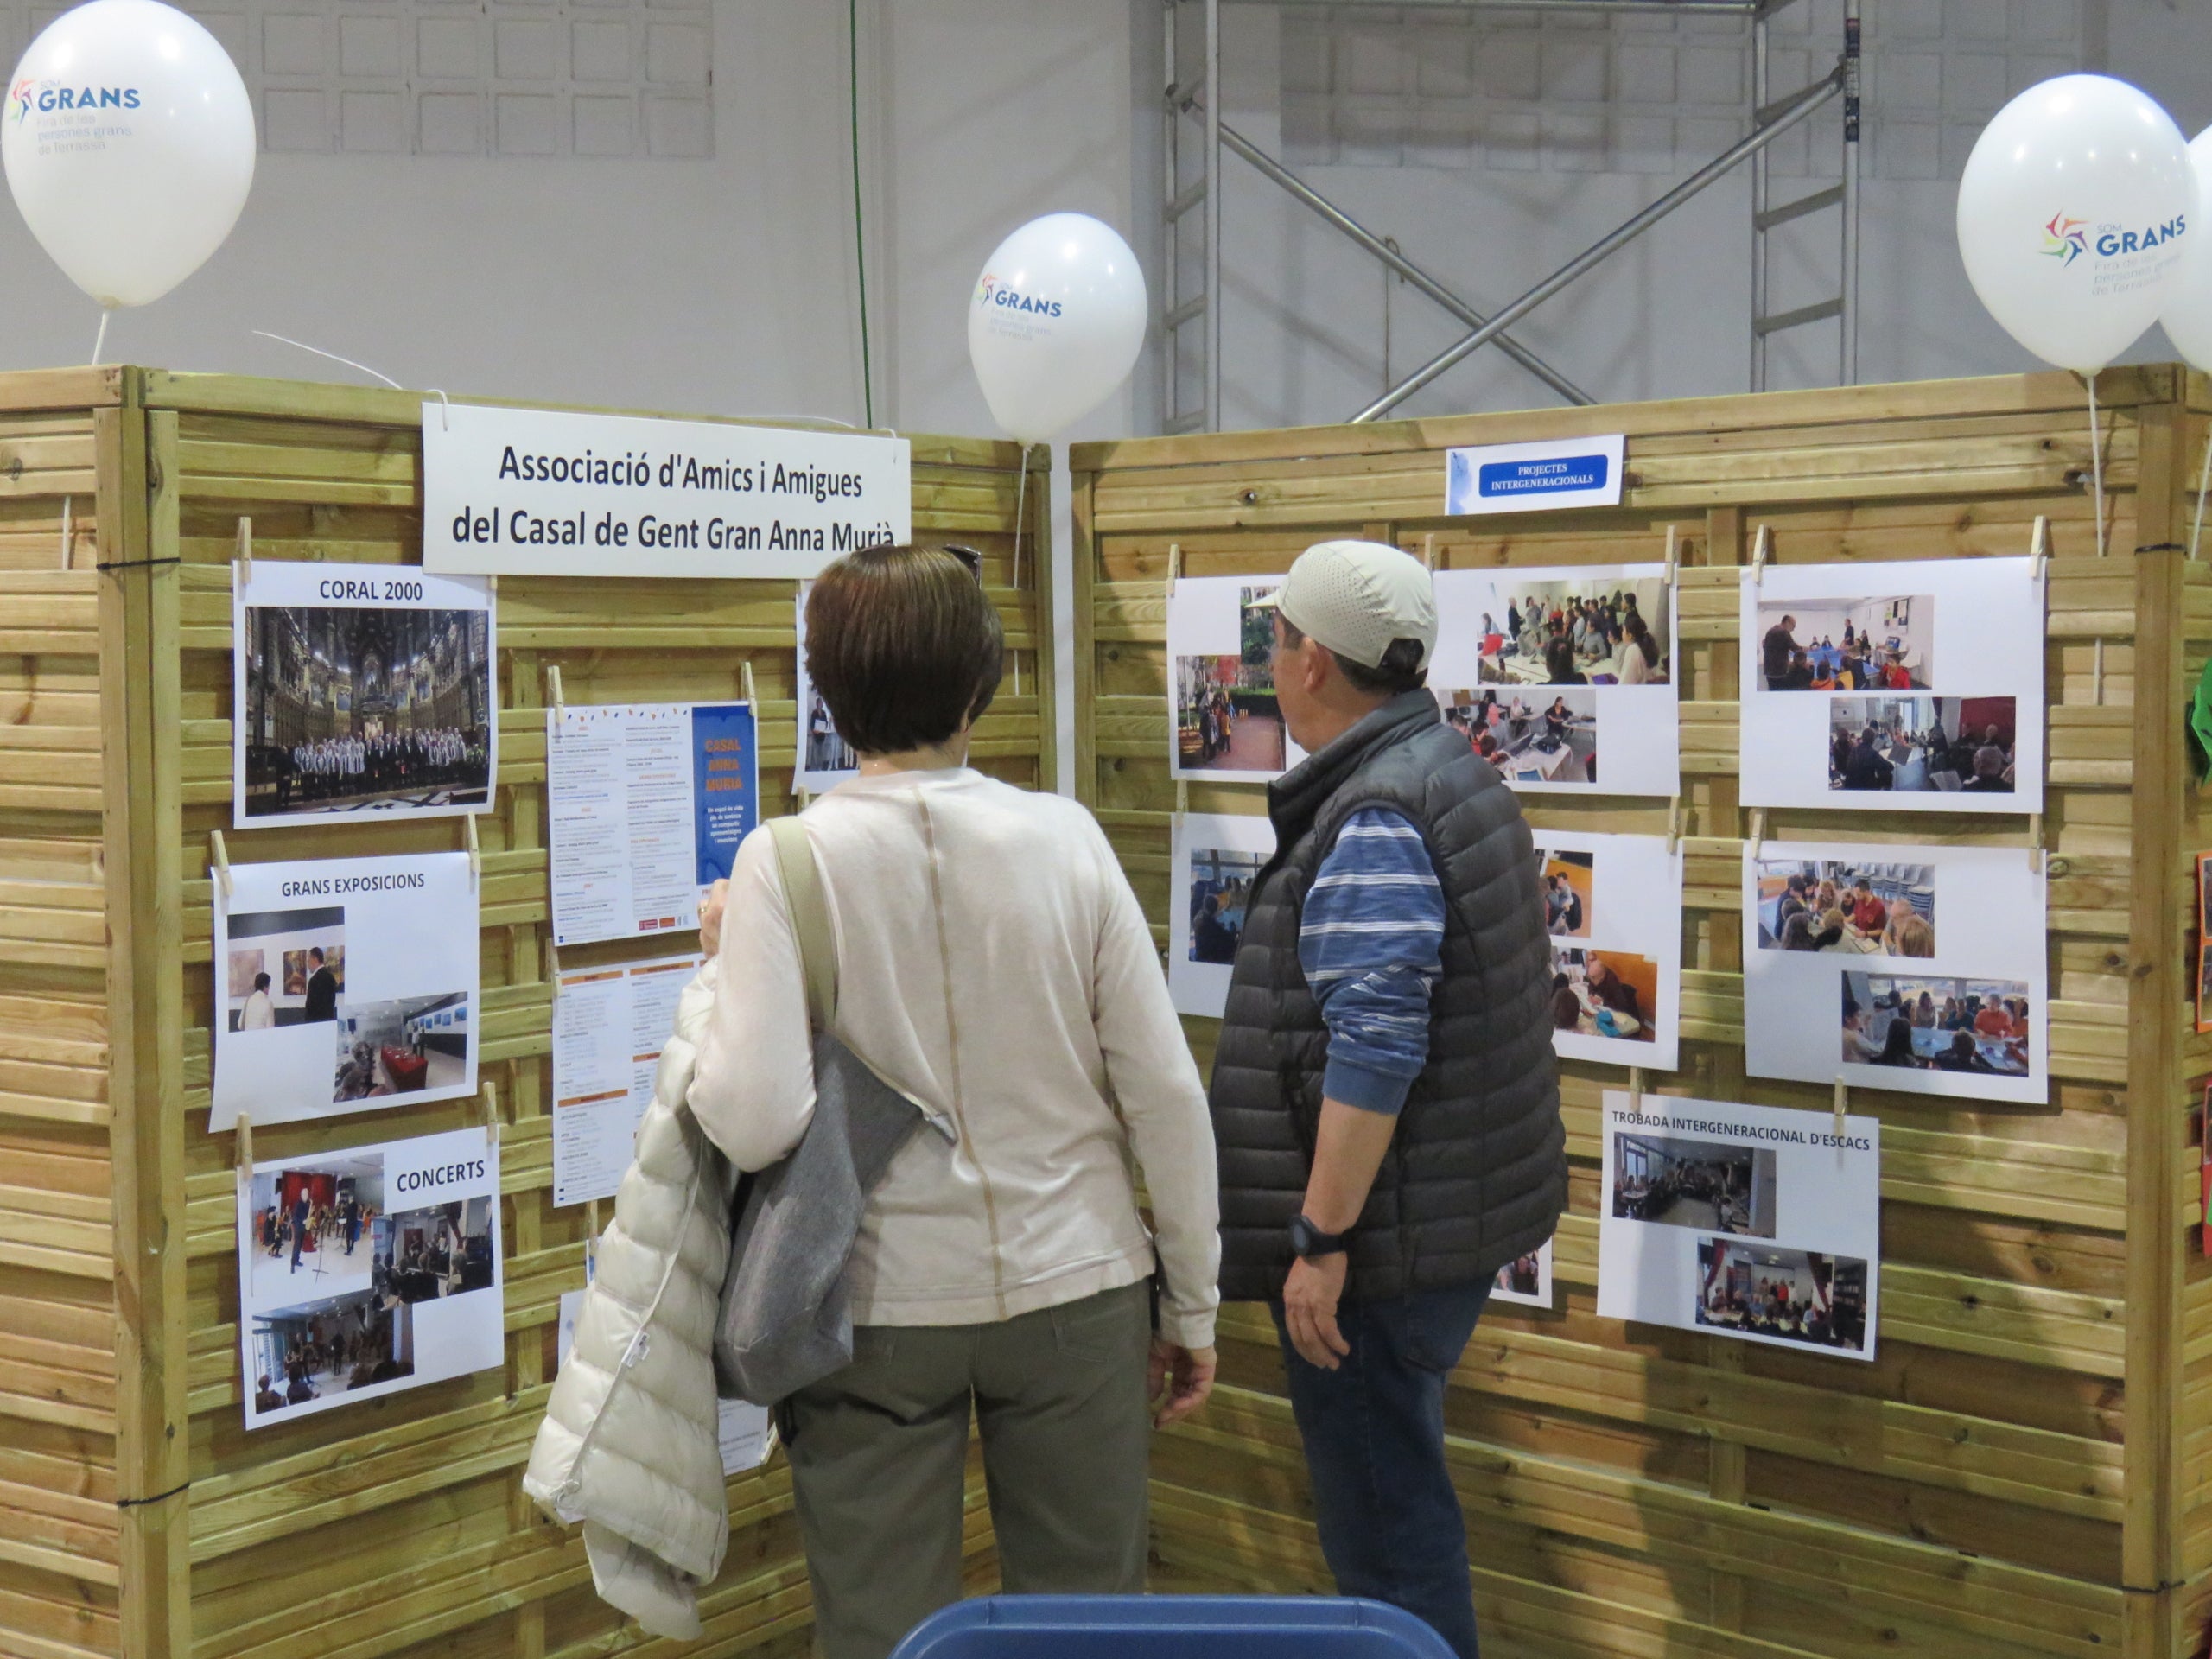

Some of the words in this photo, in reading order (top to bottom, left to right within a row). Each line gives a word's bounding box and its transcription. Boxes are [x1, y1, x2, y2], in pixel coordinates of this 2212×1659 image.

[38, 86, 142, 112] GRANS
[37, 128, 90, 143] persones
[93, 126, 132, 139] grans
[2095, 213, 2186, 257] GRANS
[2097, 223, 2122, 233] SOM
[995, 289, 1063, 318] GRANS
[499, 445, 651, 486] Associació
[658, 454, 753, 493] d'Amics
[760, 461, 766, 493] i
[772, 462, 863, 504] Amigues
[1491, 474, 1594, 491] INTERGENERACIONALS
[1518, 463, 1567, 476] PROJECTES
[452, 505, 499, 543] del
[509, 509, 585, 546] Casal
[594, 512, 629, 547] de
[638, 514, 699, 549] Gent
[707, 517, 761, 550] Gran
[768, 519, 824, 551] Anna
[320, 580, 379, 600] CORAL
[385, 582, 423, 601] 2000
[282, 880, 331, 898] GRANS
[334, 873, 425, 893] EXPOSICIONS
[1612, 1110, 1669, 1128] TROBADA
[1672, 1117, 1806, 1144] INTERGENERACIONAL
[1810, 1133, 1870, 1151] D'ESCACS
[397, 1160, 485, 1192] CONCERTS
